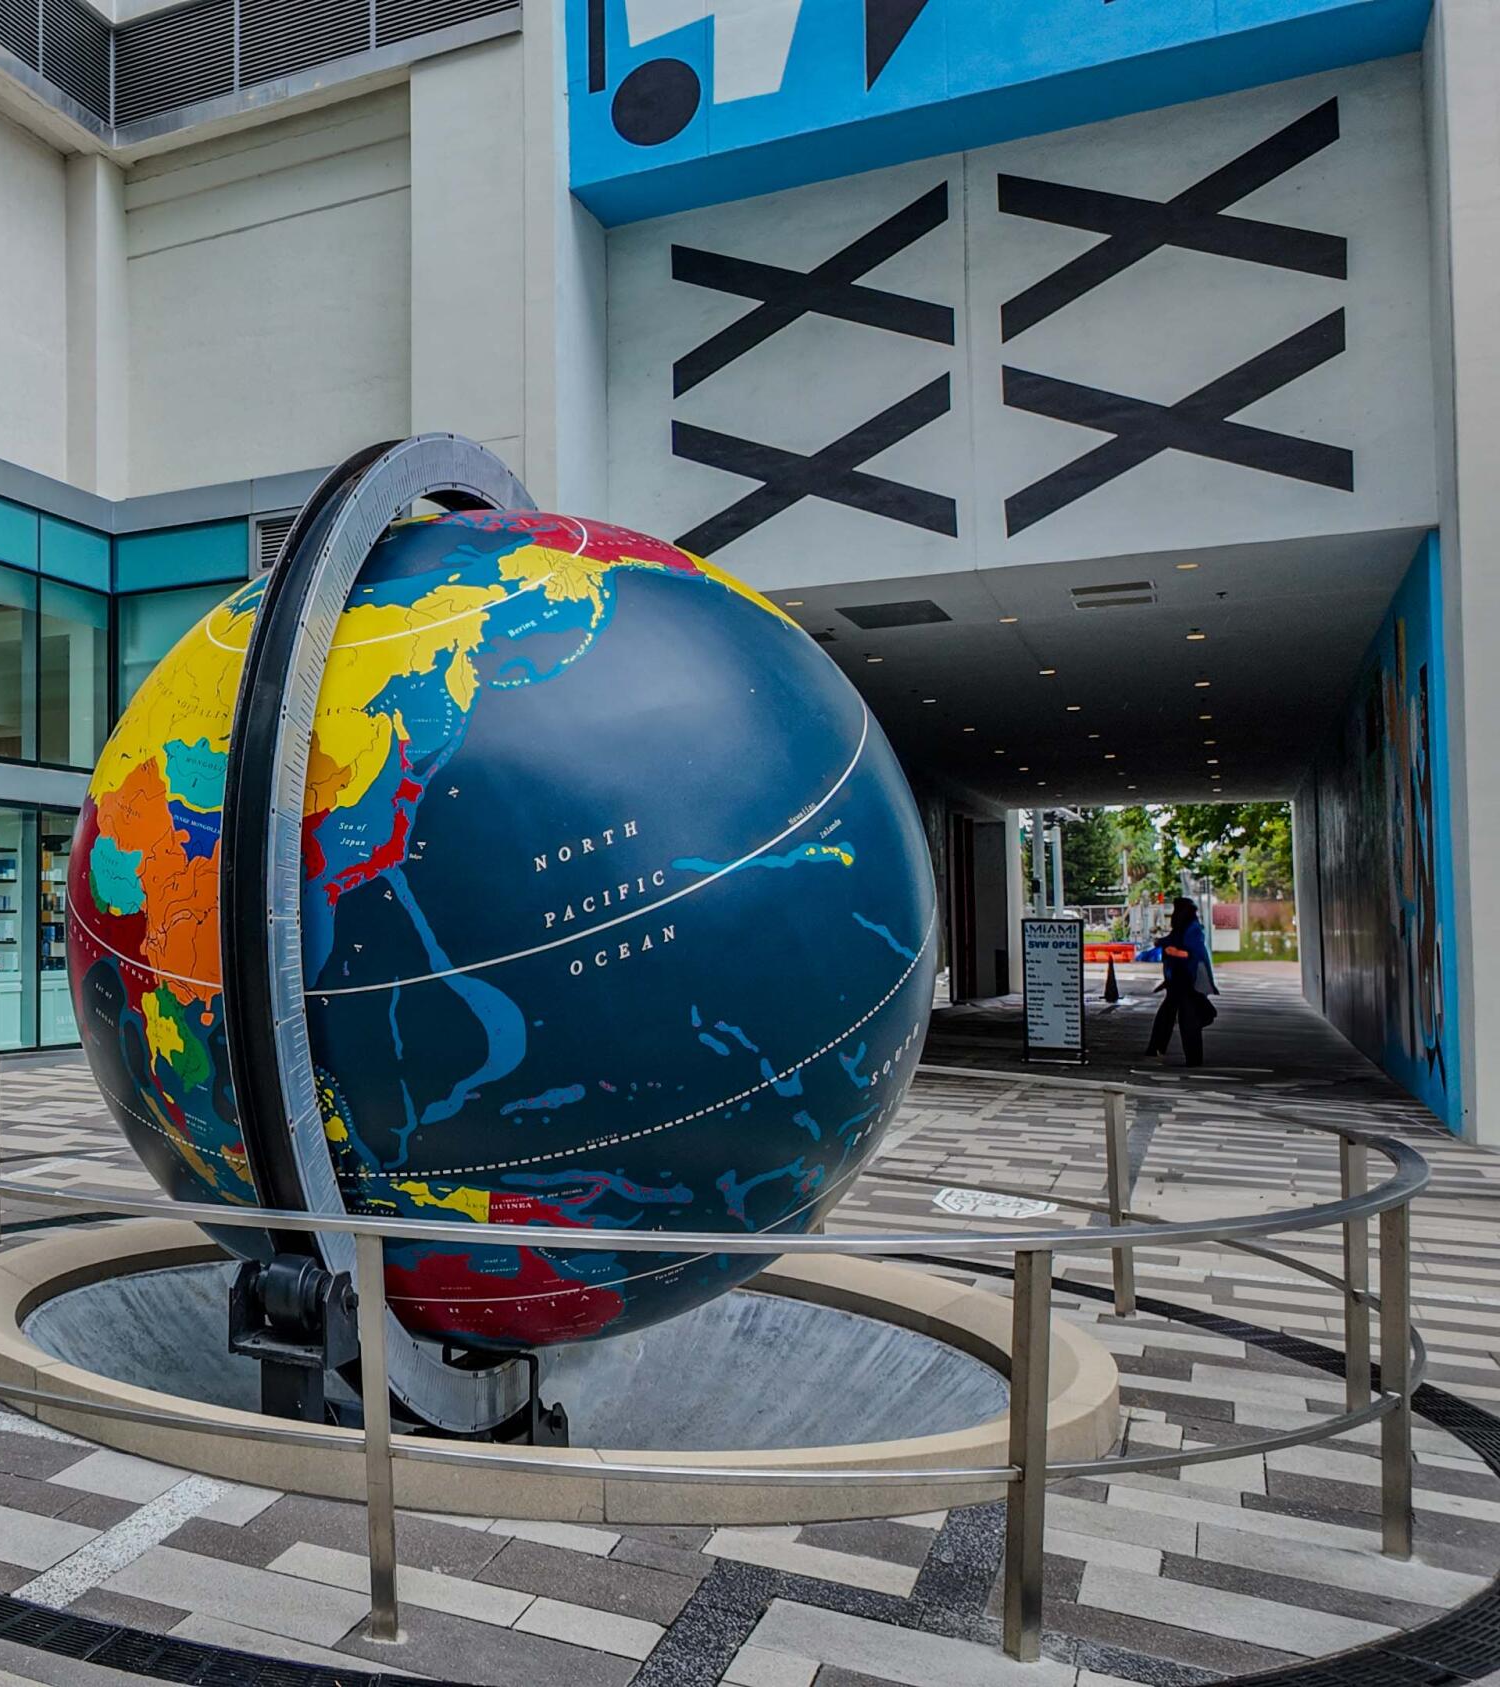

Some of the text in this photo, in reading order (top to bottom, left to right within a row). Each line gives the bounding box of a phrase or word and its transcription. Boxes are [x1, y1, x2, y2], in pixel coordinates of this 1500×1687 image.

[338, 822, 355, 831] Sea
[339, 837, 366, 849] Japan
[534, 820, 639, 872] NORTH
[544, 870, 666, 928] PACIFIC
[1028, 924, 1077, 934] MIAMI
[569, 924, 677, 977] OCEAN
[1052, 941, 1078, 949] OPEN
